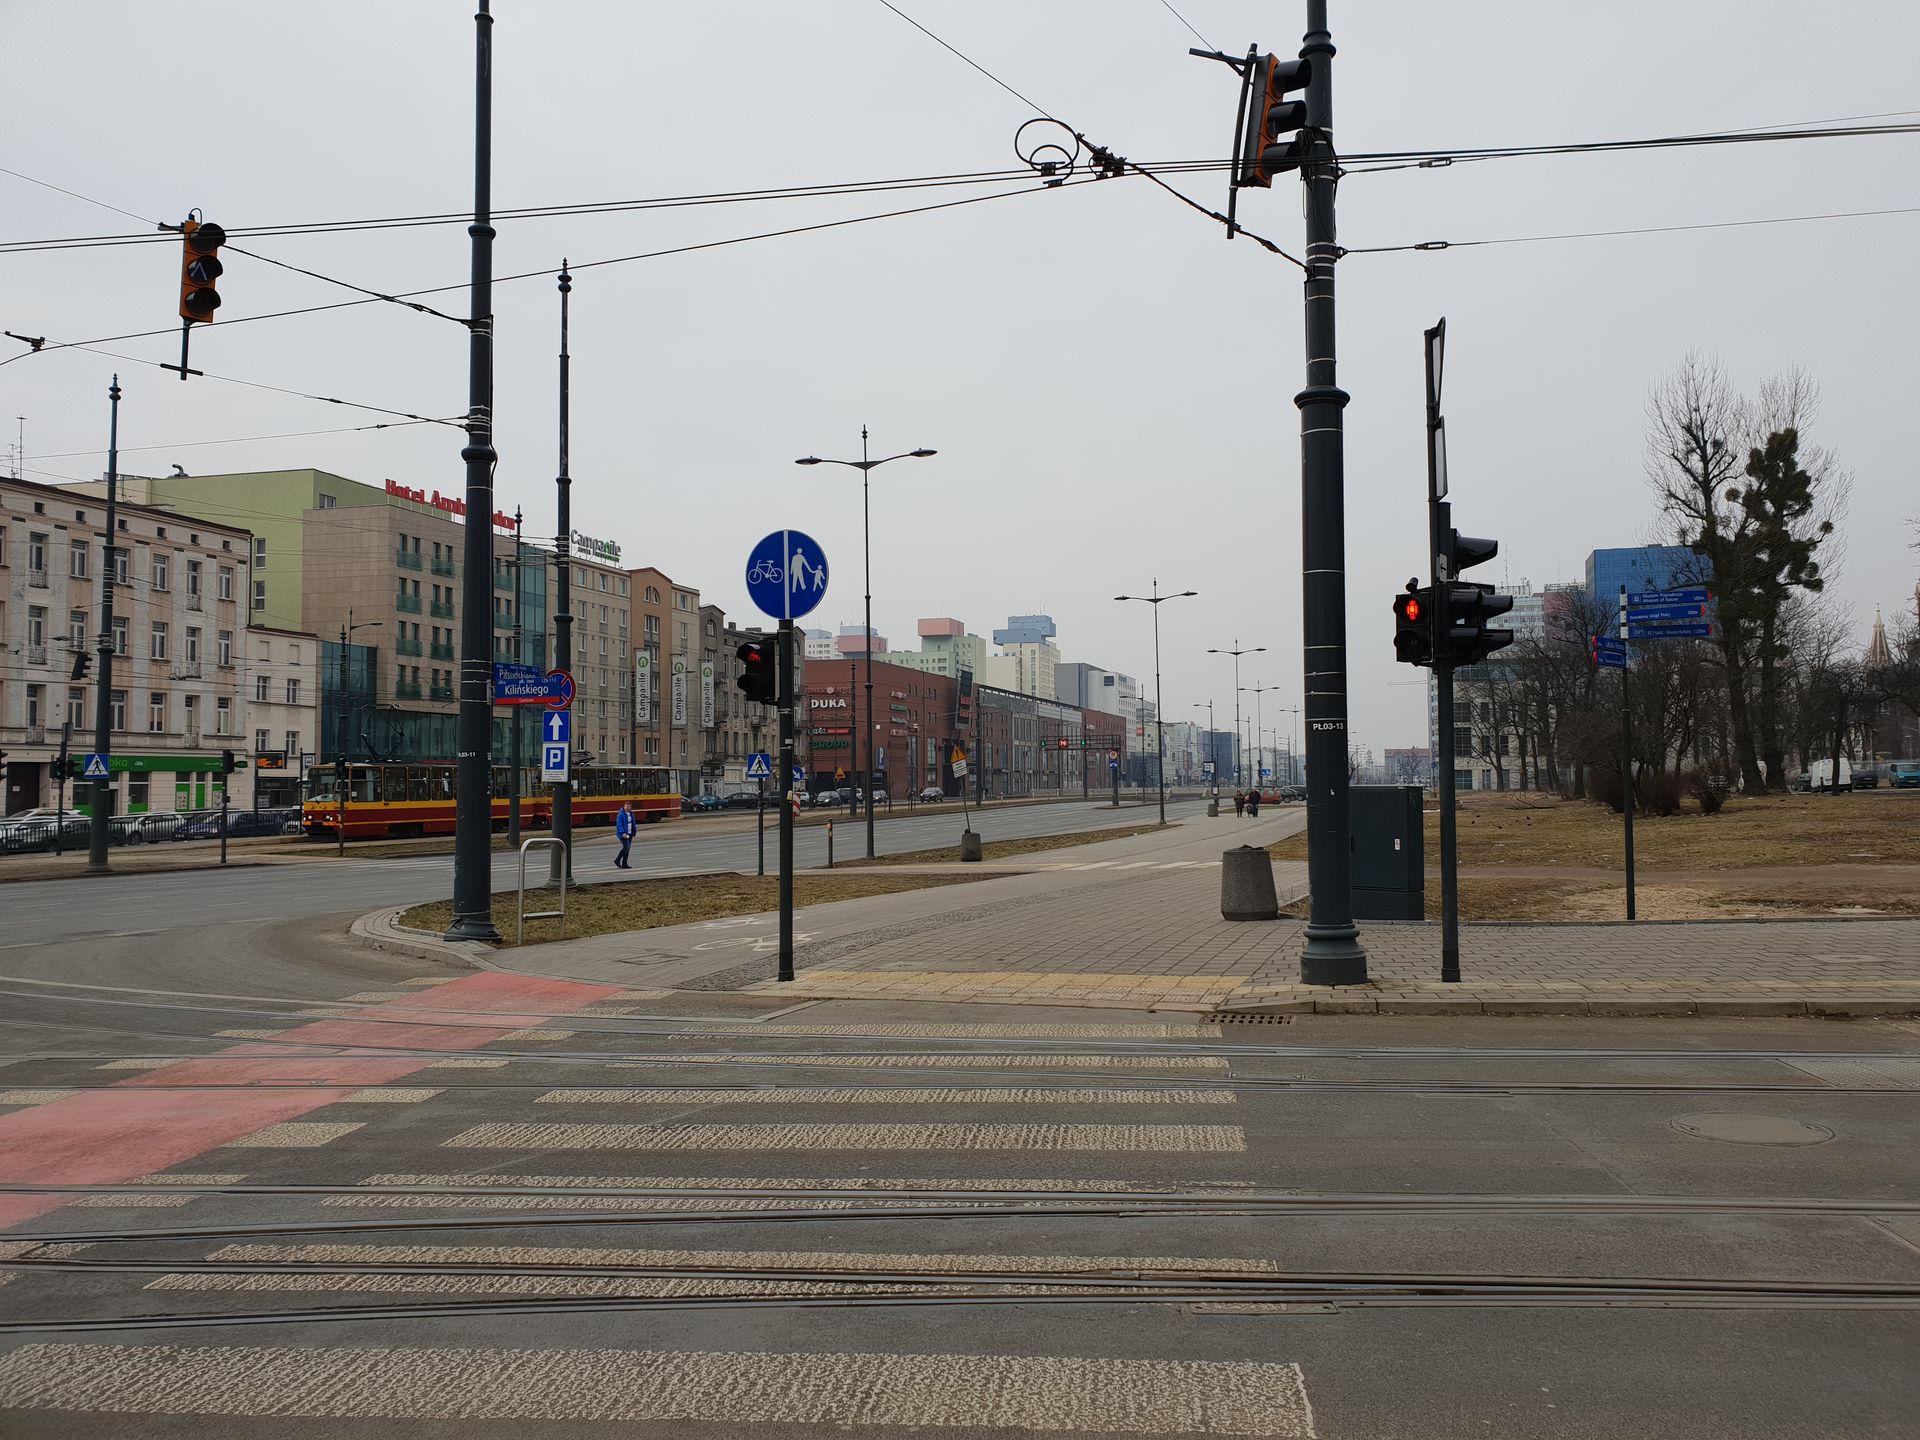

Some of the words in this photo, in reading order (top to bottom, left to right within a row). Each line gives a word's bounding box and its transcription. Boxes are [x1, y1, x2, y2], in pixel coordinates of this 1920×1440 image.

[385, 479, 425, 504] Hotel
[570, 529, 622, 558] Campanile
[504, 684, 549, 697] Kilińskiego
[638, 672, 648, 718] Campanile
[674, 677, 684, 721] Campanile
[703, 681, 712, 724] Campanile
[811, 699, 847, 708] DUKA
[550, 749, 562, 768] P
